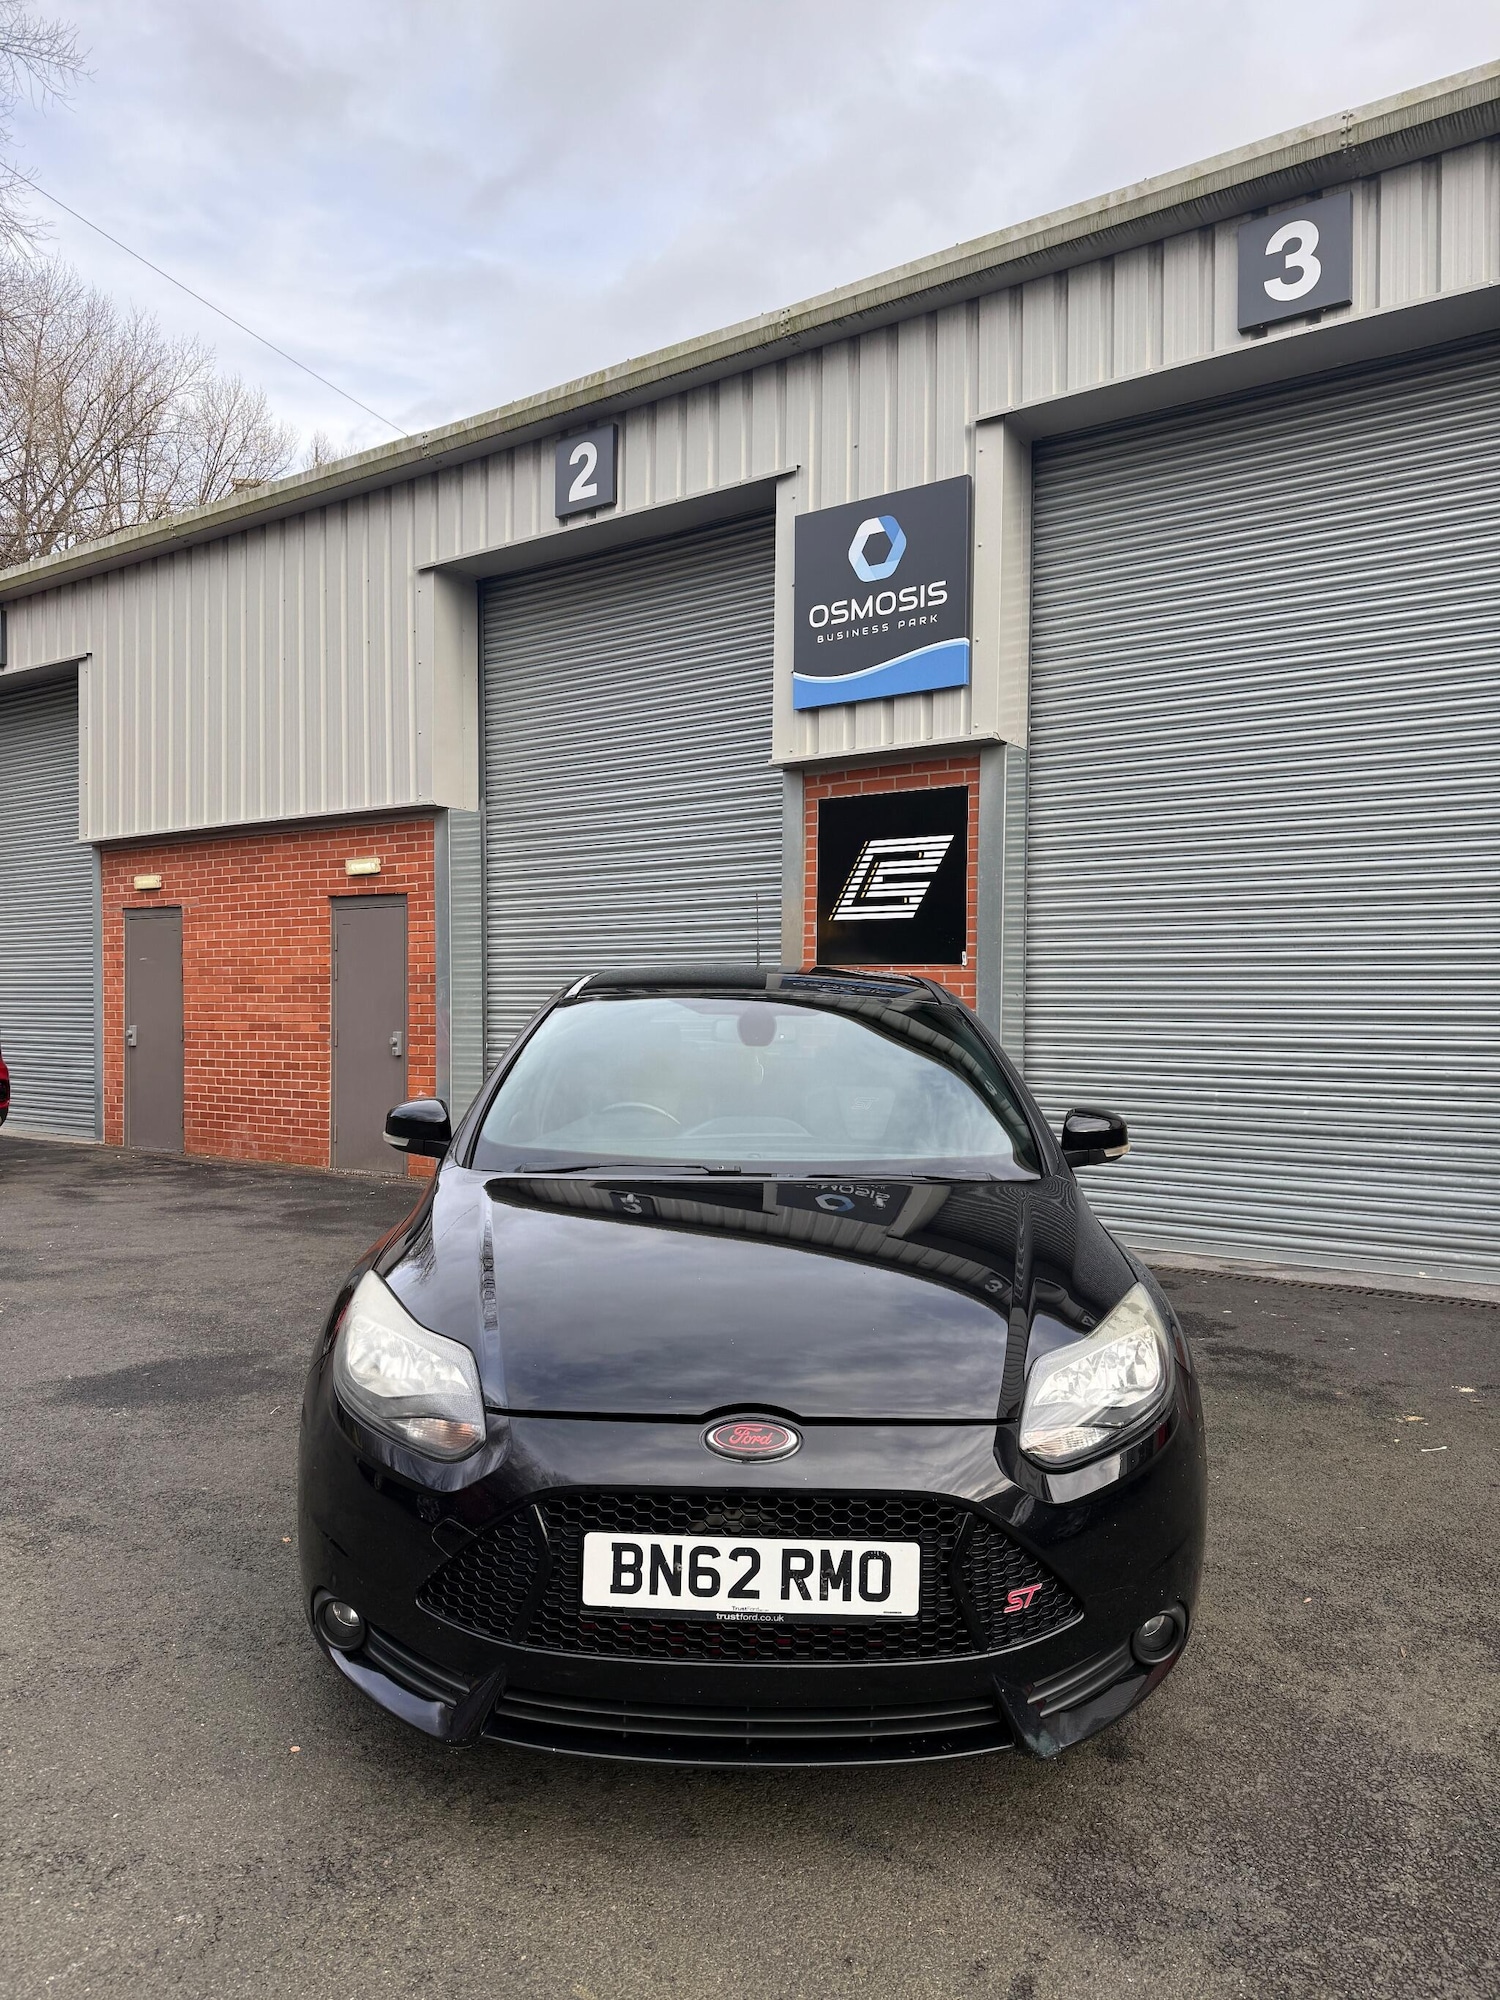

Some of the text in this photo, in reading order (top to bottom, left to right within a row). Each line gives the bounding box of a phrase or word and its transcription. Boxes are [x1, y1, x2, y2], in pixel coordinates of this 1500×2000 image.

[1263, 219, 1322, 301] 3
[568, 441, 598, 503] 2
[808, 580, 948, 628] OSMOSIS
[817, 614, 938, 644] BUSINESS PARK
[728, 1426, 773, 1445] Ford
[610, 1542, 892, 1602] BN62 RMO
[716, 1612, 785, 1622] trustford.co.uk
[1003, 1582, 1043, 1613] ST
